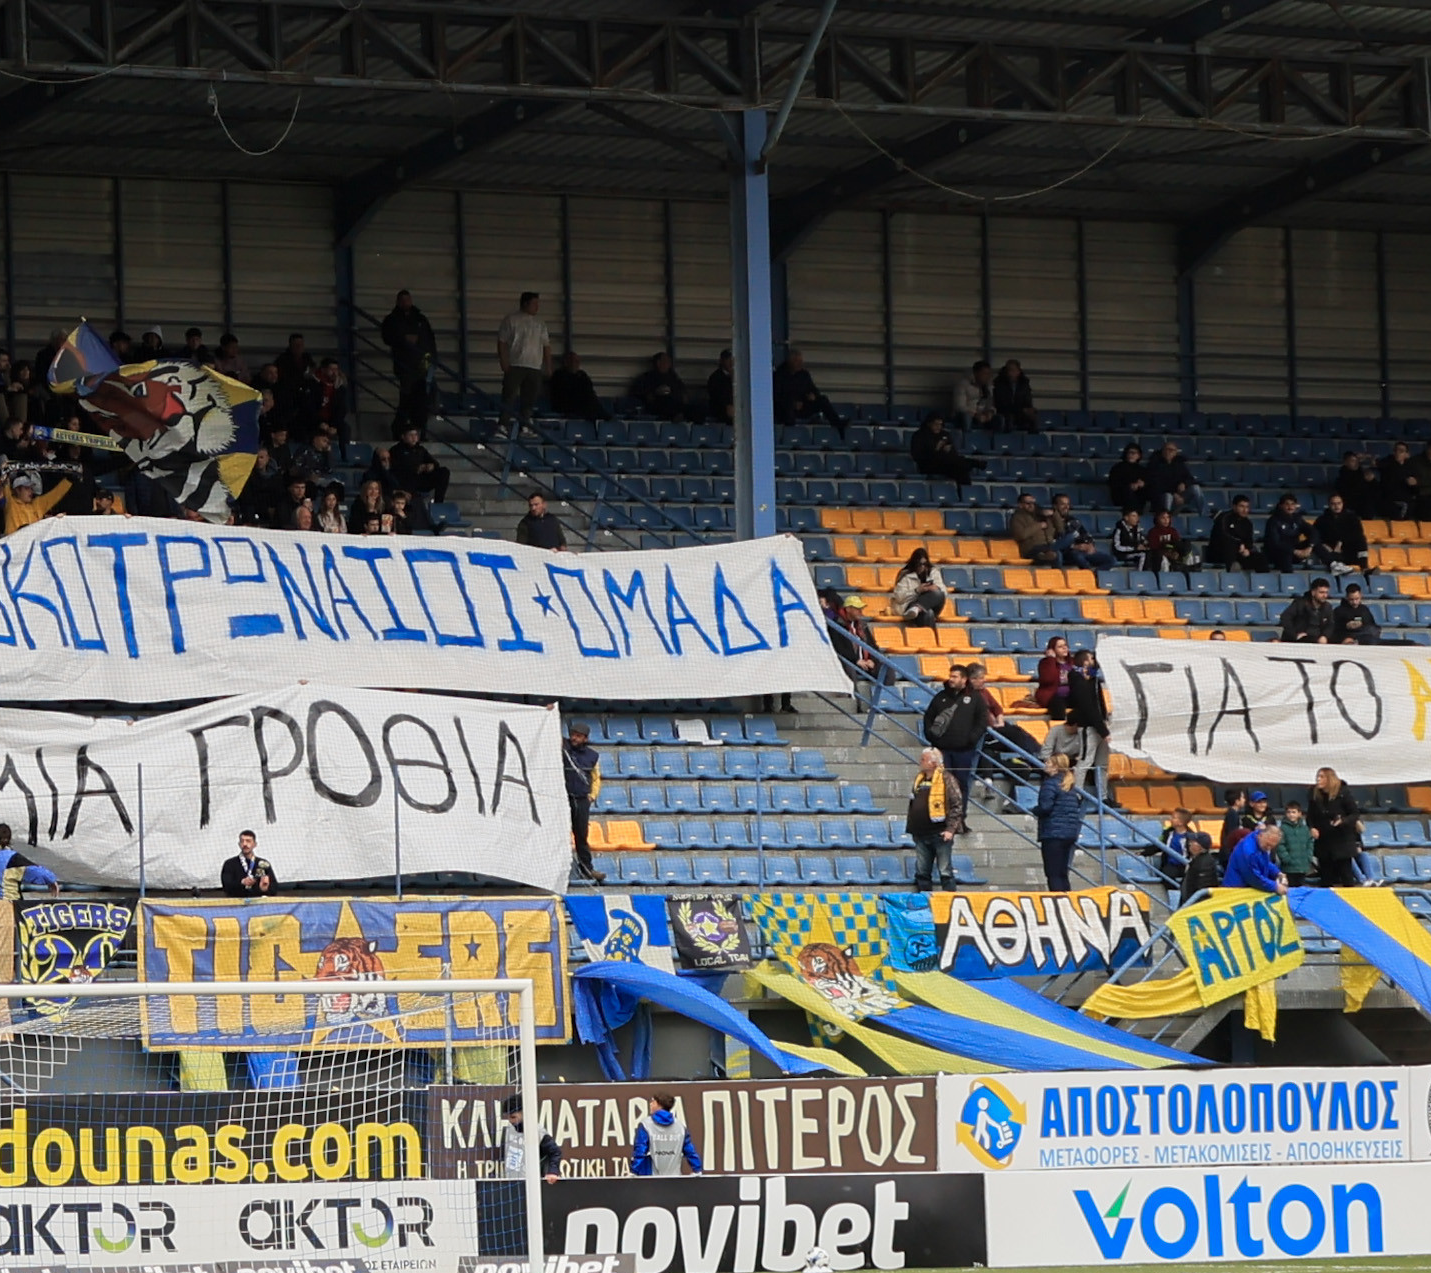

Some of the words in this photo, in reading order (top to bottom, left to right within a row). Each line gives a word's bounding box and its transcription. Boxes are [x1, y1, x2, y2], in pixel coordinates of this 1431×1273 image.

[545, 557, 830, 659] ΟΜΑΔΑ
[1120, 657, 1261, 756] ΓΙΑ
[1267, 655, 1382, 745] ΤΟ
[186, 699, 542, 829] ΓΡΟΘΙΑ
[21, 902, 131, 936] TIGERS
[940, 890, 1152, 973] ΑΘΗΝΑ
[1186, 894, 1300, 987] ΑΡΓΟΣ
[702, 1082, 926, 1173] ΠΙΤΕΡΟΣ
[1040, 1079, 1399, 1139] ΑΠΟΣΤΟΛΟΠΟΥΛΟΣ
[1039, 1145, 1140, 1168] ΜΕΤΑΦΟΡΕΣ
[1154, 1142, 1272, 1165] ΜΕΤΑΚΟΜΙΣΕΙΣ
[1287, 1139, 1403, 1161] ΑΠΟΘΗΚΕΥΣΕΙΣ
[381, 1259, 436, 1271] ΕΤΑΙΡΕΙΩΝ
